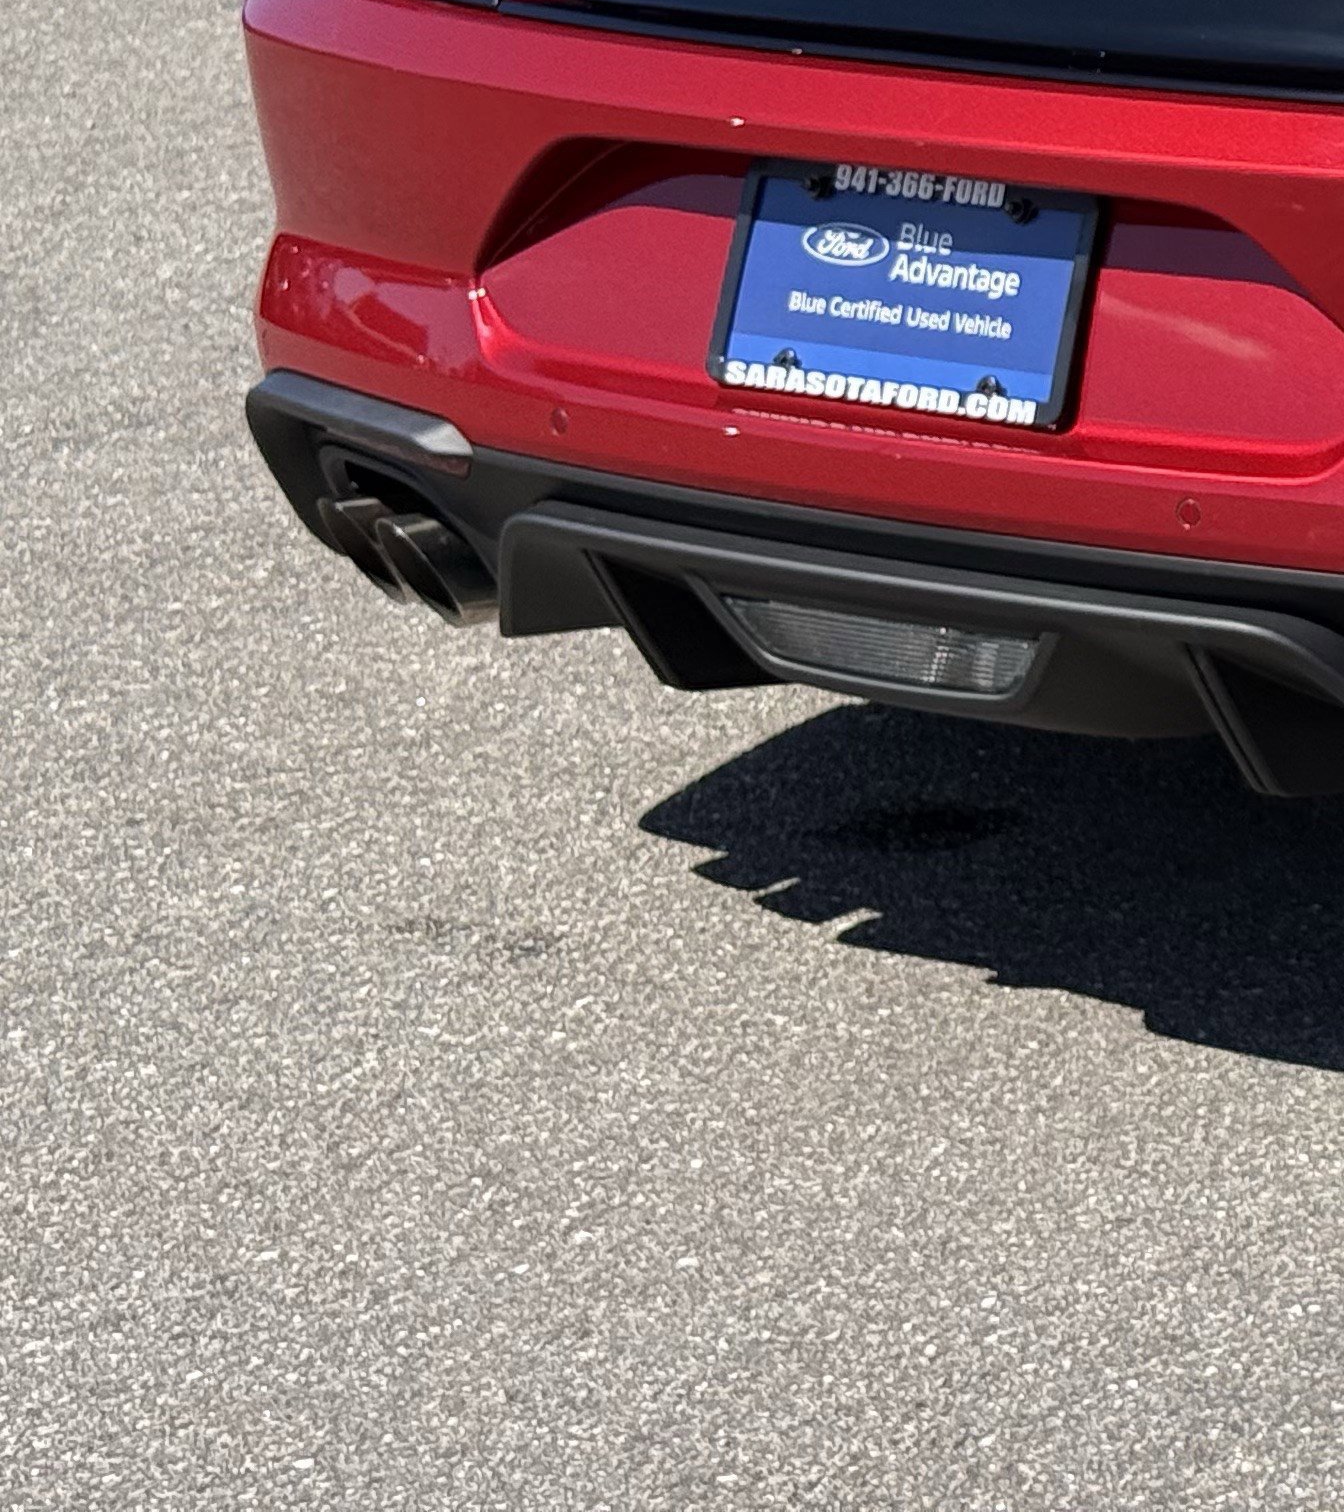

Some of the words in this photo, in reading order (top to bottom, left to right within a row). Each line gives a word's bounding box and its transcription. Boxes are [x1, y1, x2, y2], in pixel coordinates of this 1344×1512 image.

[834, 164, 1007, 209] 941-366-FORD
[817, 230, 875, 259] Ford
[897, 223, 954, 256] Blue
[889, 255, 1021, 300] Advantage
[788, 290, 827, 315] Blue
[830, 295, 901, 326] Certified
[906, 305, 950, 332] Used
[955, 314, 1013, 340] Vehicle
[724, 360, 1038, 426] SARASOTAFORD.COM
